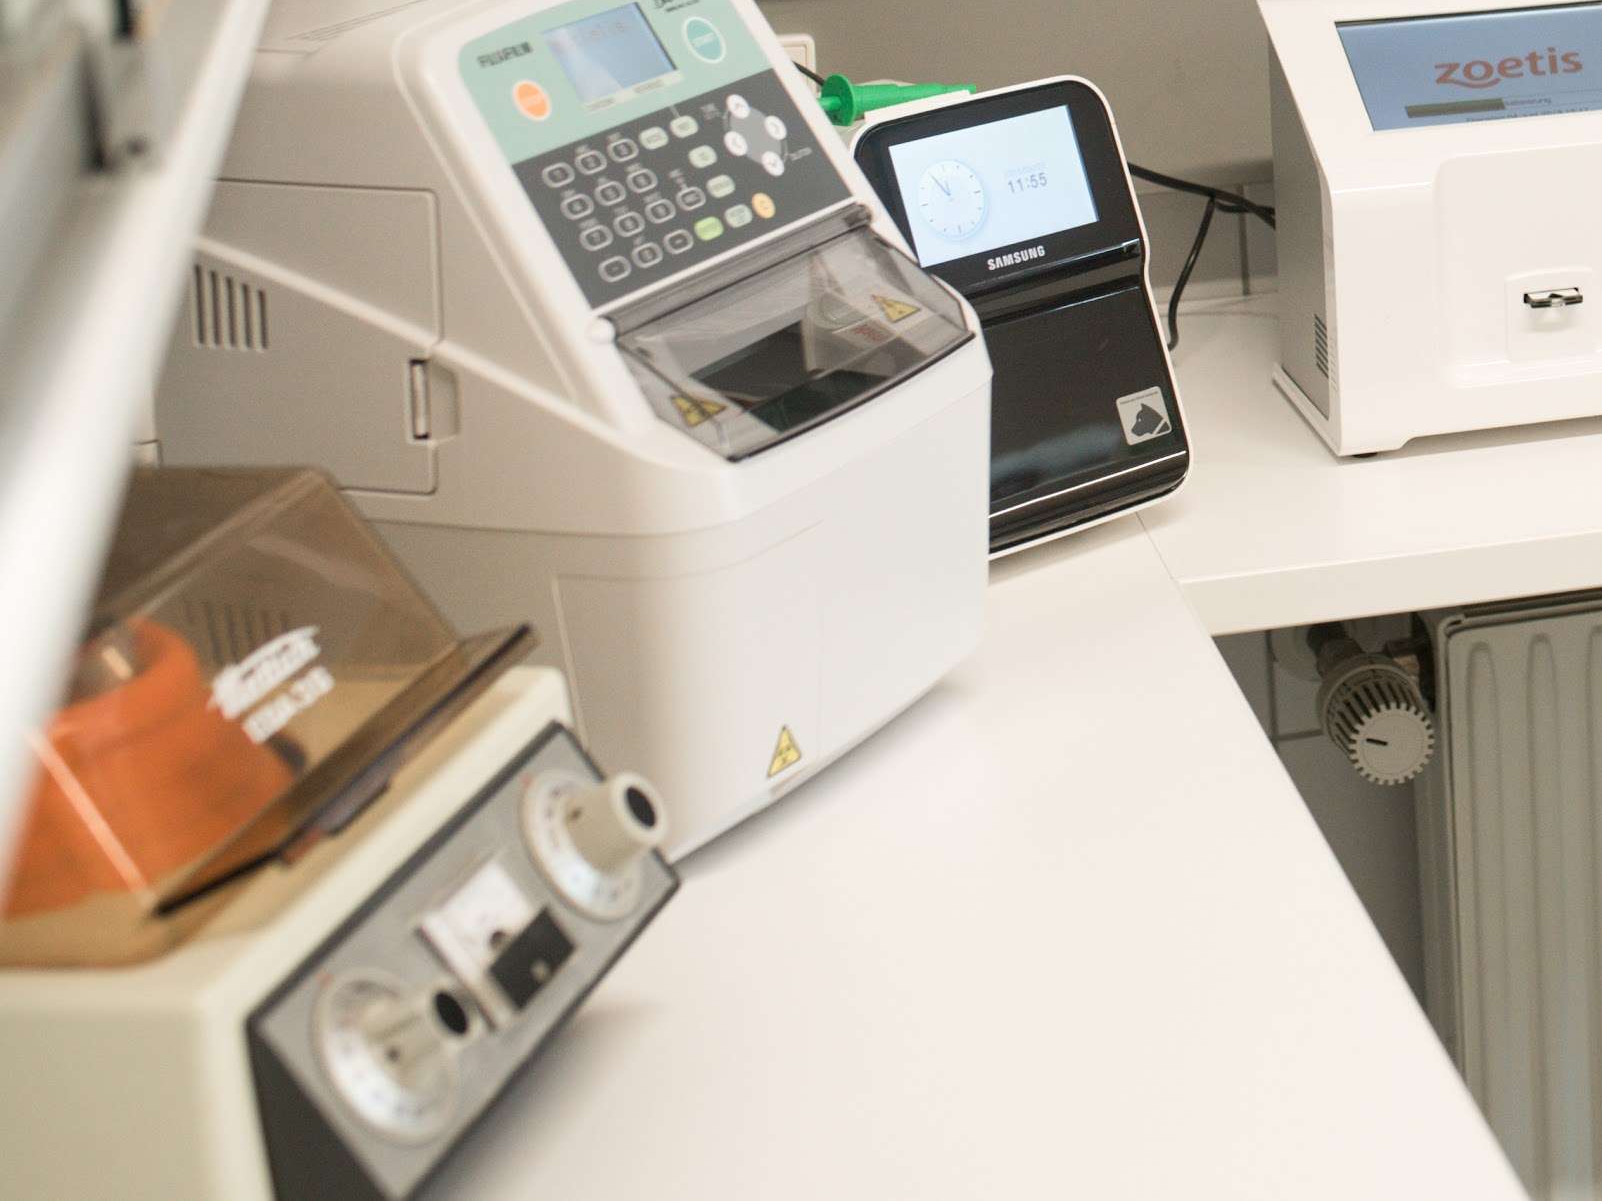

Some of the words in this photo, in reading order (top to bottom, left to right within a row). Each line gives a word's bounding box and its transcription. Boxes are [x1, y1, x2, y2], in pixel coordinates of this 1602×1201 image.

[1434, 47, 1583, 89] zoetis
[1008, 172, 1048, 193] 11:55
[987, 245, 1046, 271] SAMSUNG
